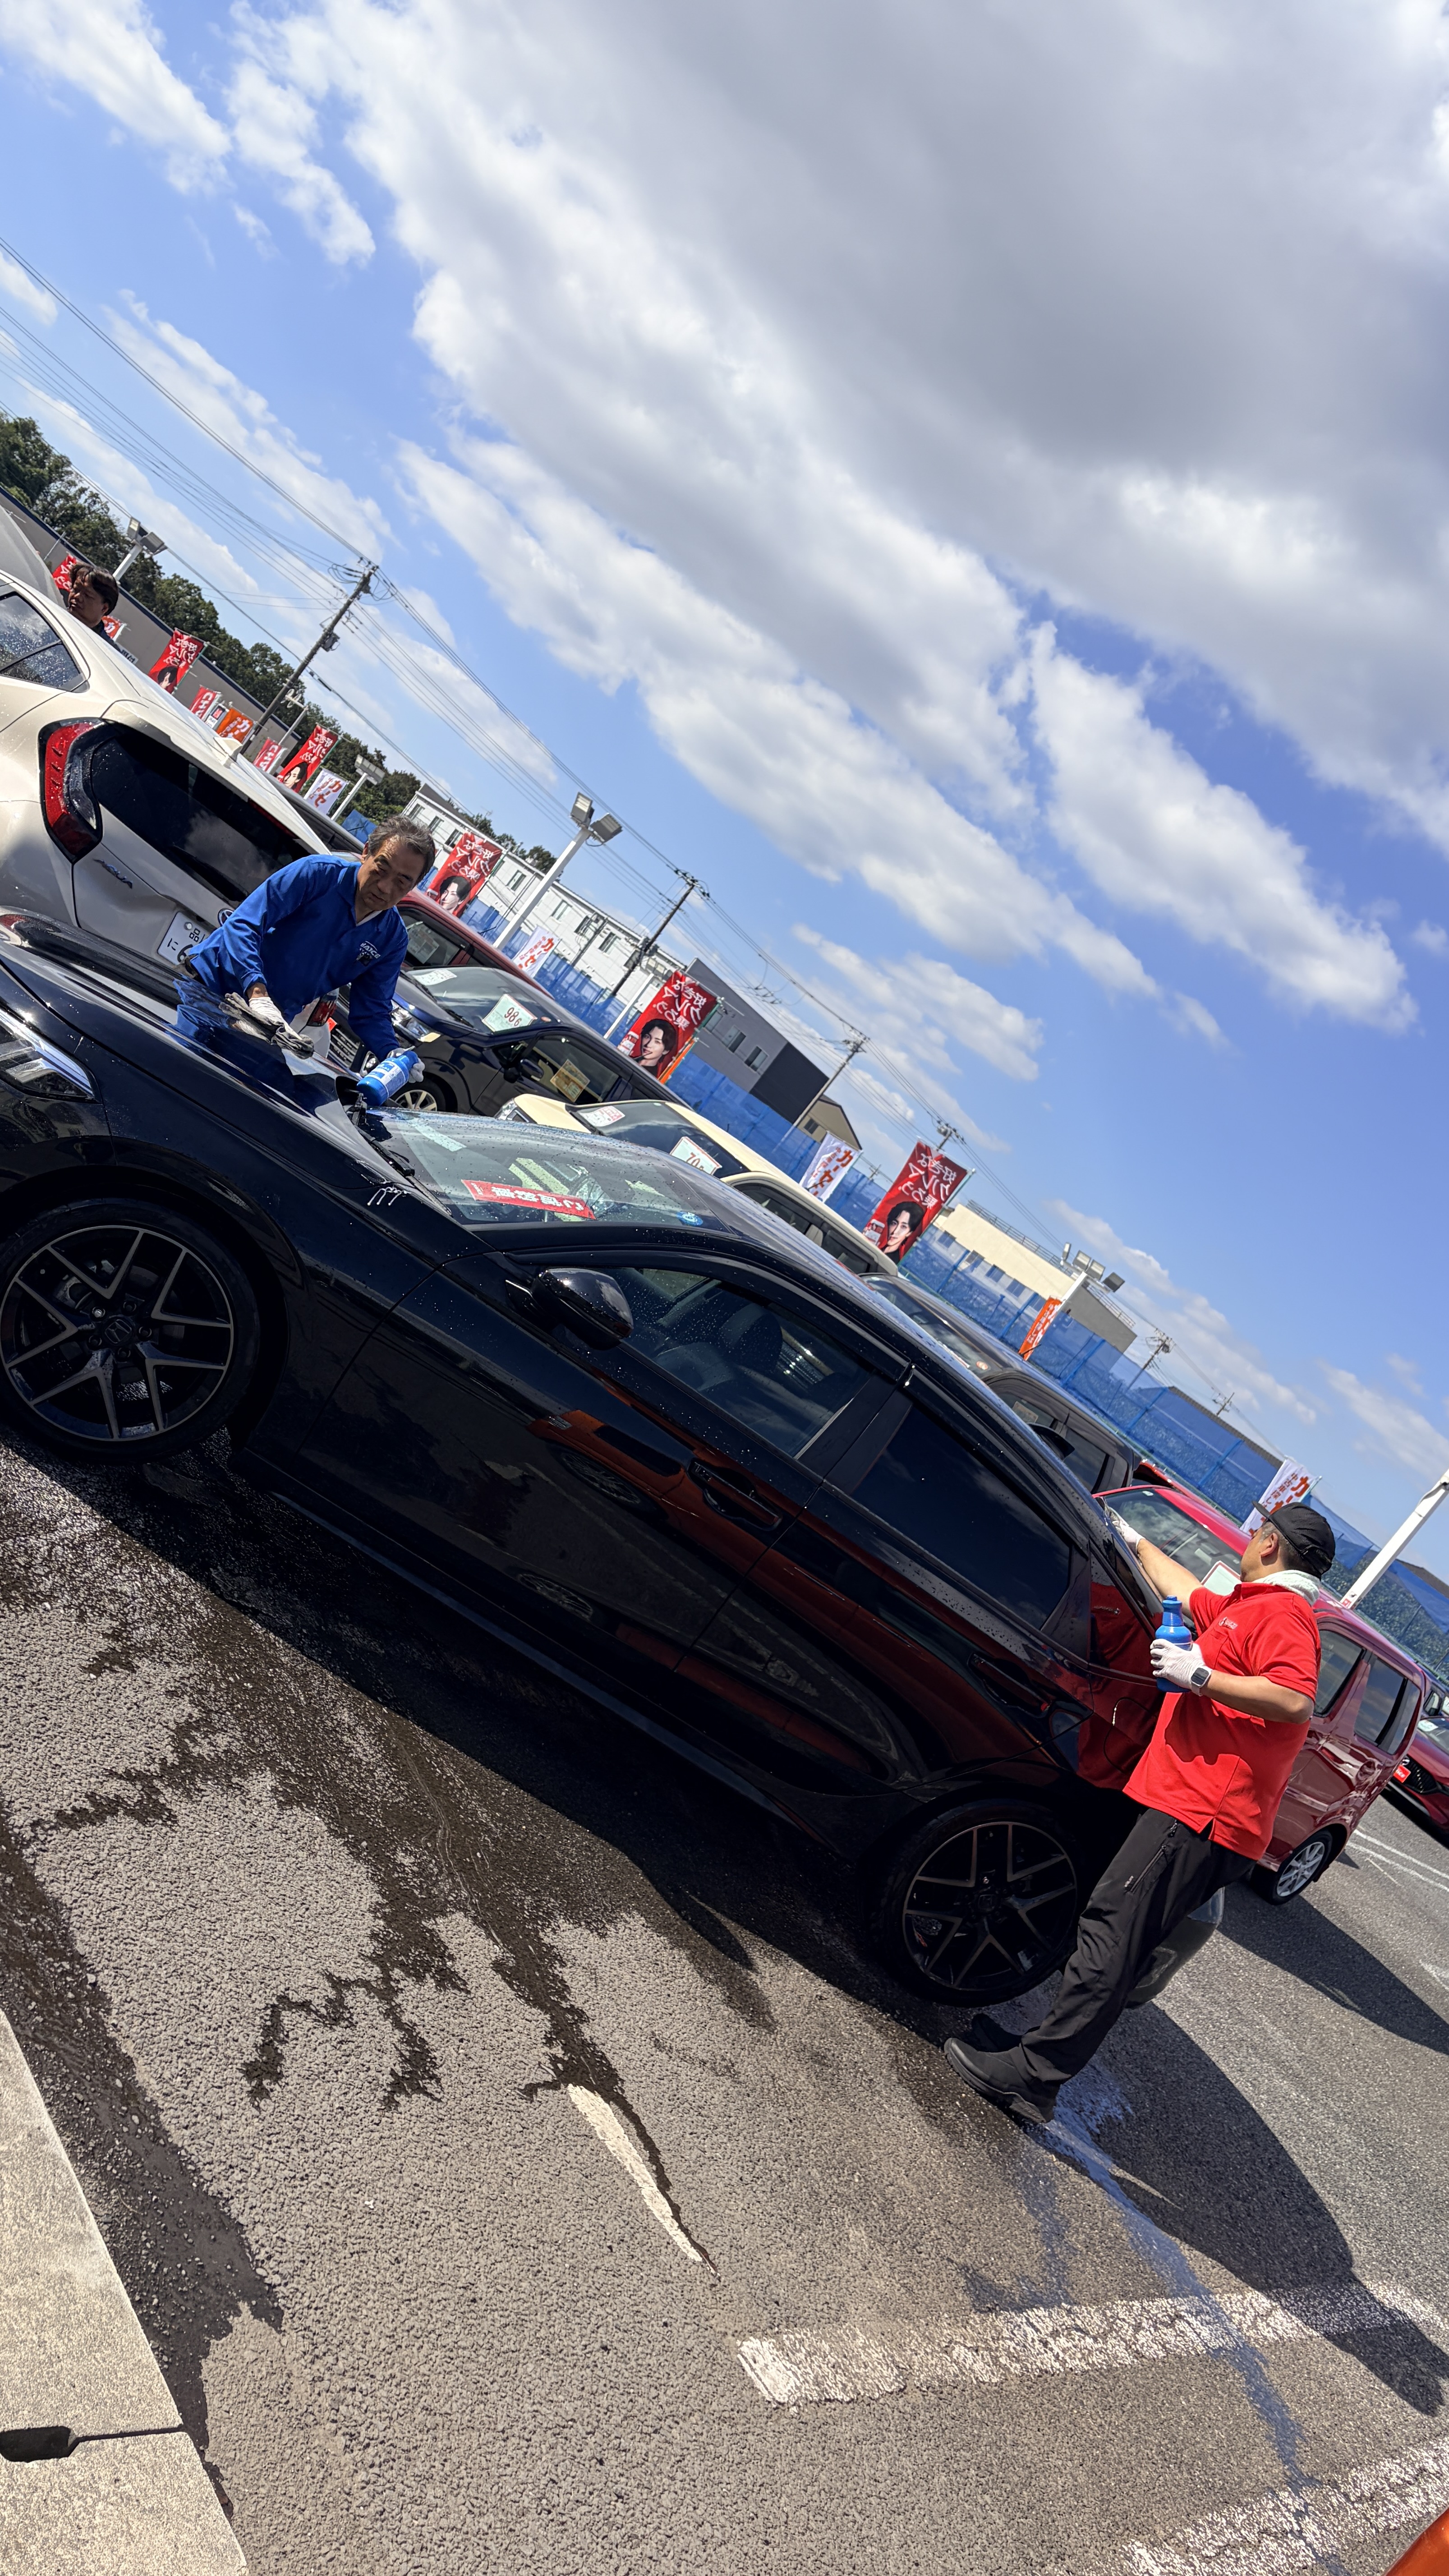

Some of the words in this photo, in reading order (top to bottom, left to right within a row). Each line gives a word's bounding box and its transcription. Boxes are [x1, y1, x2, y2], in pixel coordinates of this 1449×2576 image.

[167, 938, 179, 951] に
[518, 938, 554, 969] カーセ
